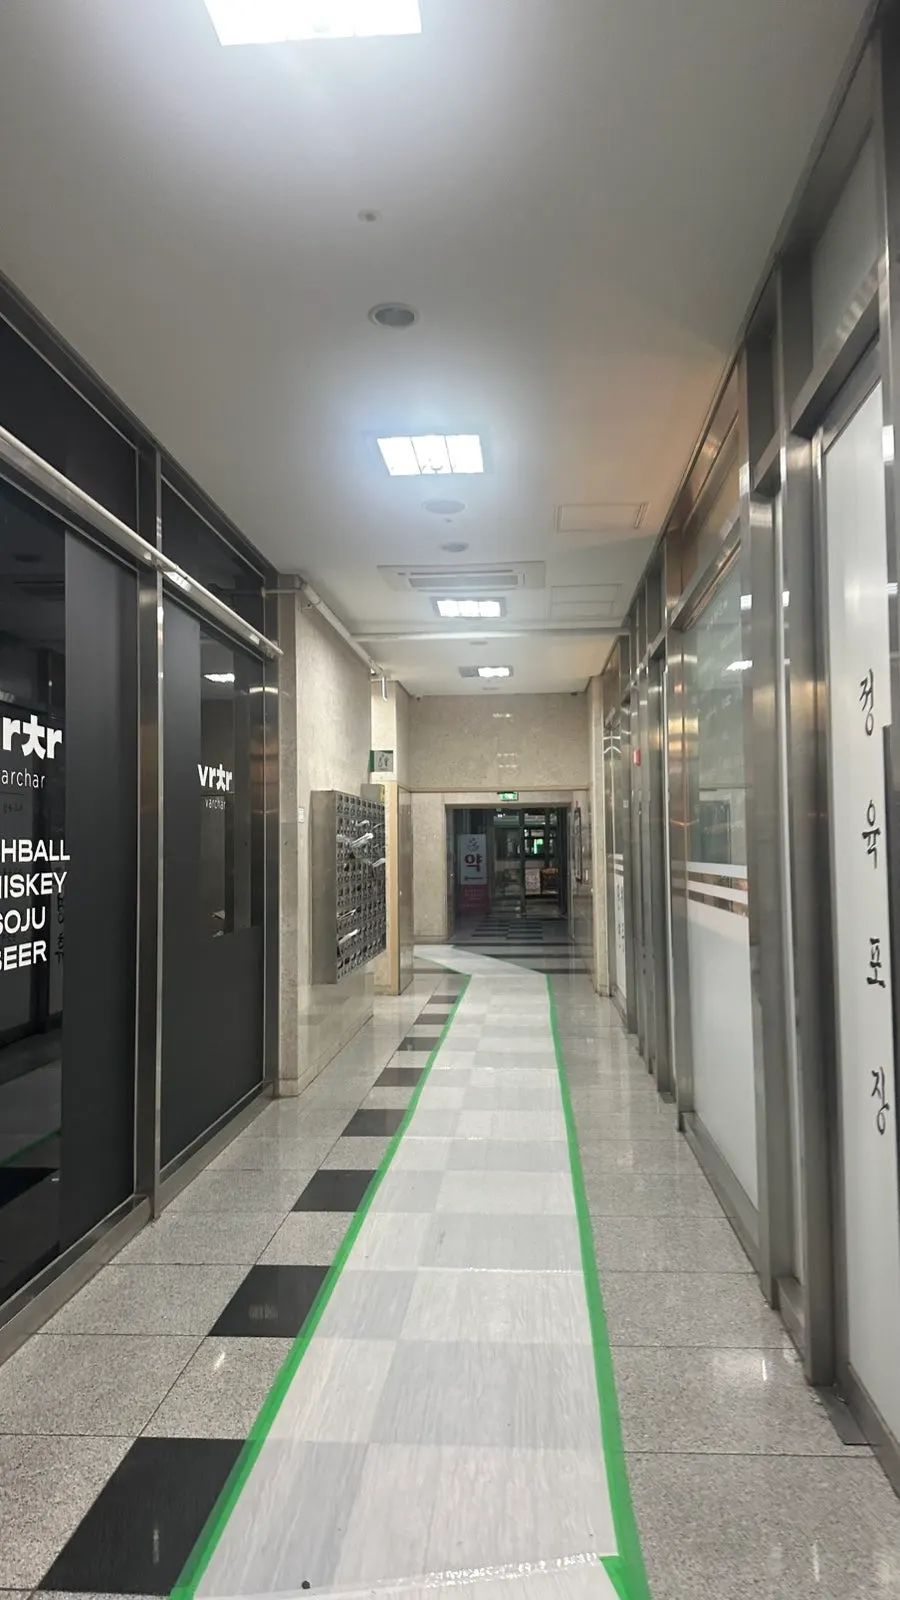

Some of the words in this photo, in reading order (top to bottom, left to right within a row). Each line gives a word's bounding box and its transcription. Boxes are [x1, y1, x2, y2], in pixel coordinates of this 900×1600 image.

[1, 767, 46, 788] archar
[1, 838, 71, 863] HBALL
[464, 853, 483, 872] 약
[0, 871, 68, 899] ISKEY
[0, 906, 46, 935] OJU
[0, 939, 48, 971] EER
